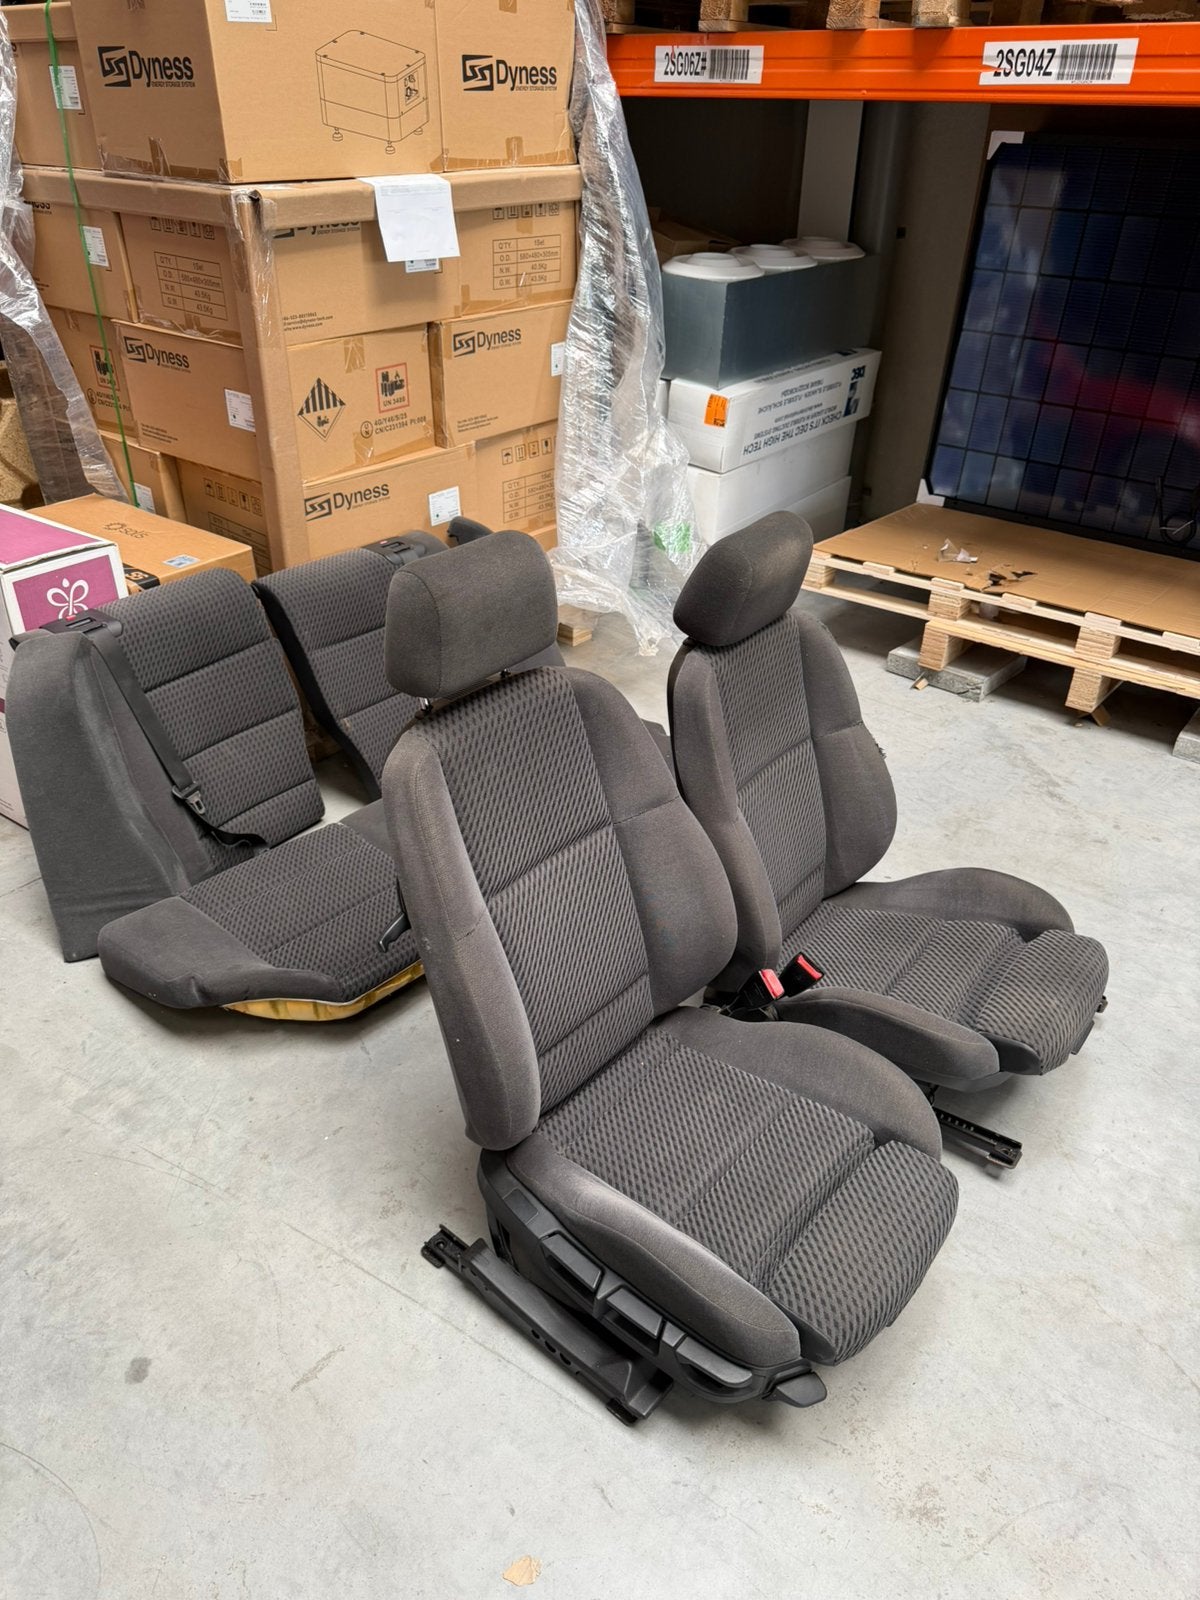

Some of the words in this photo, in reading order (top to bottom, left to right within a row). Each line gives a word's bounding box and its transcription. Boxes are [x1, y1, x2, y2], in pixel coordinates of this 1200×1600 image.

[129, 50, 194, 88] Dyness
[993, 48, 1056, 78] 2SG04Z
[496, 59, 557, 91] Dyness
[477, 328, 521, 350] Dyness
[145, 343, 190, 369] Dyness
[821, 411, 842, 426] CHECK
[763, 434, 780, 448] HIGH
[780, 429, 794, 441] THE
[795, 424, 808, 437] DEC
[743, 440, 762, 455] TECH
[333, 483, 389, 510] Dyness
